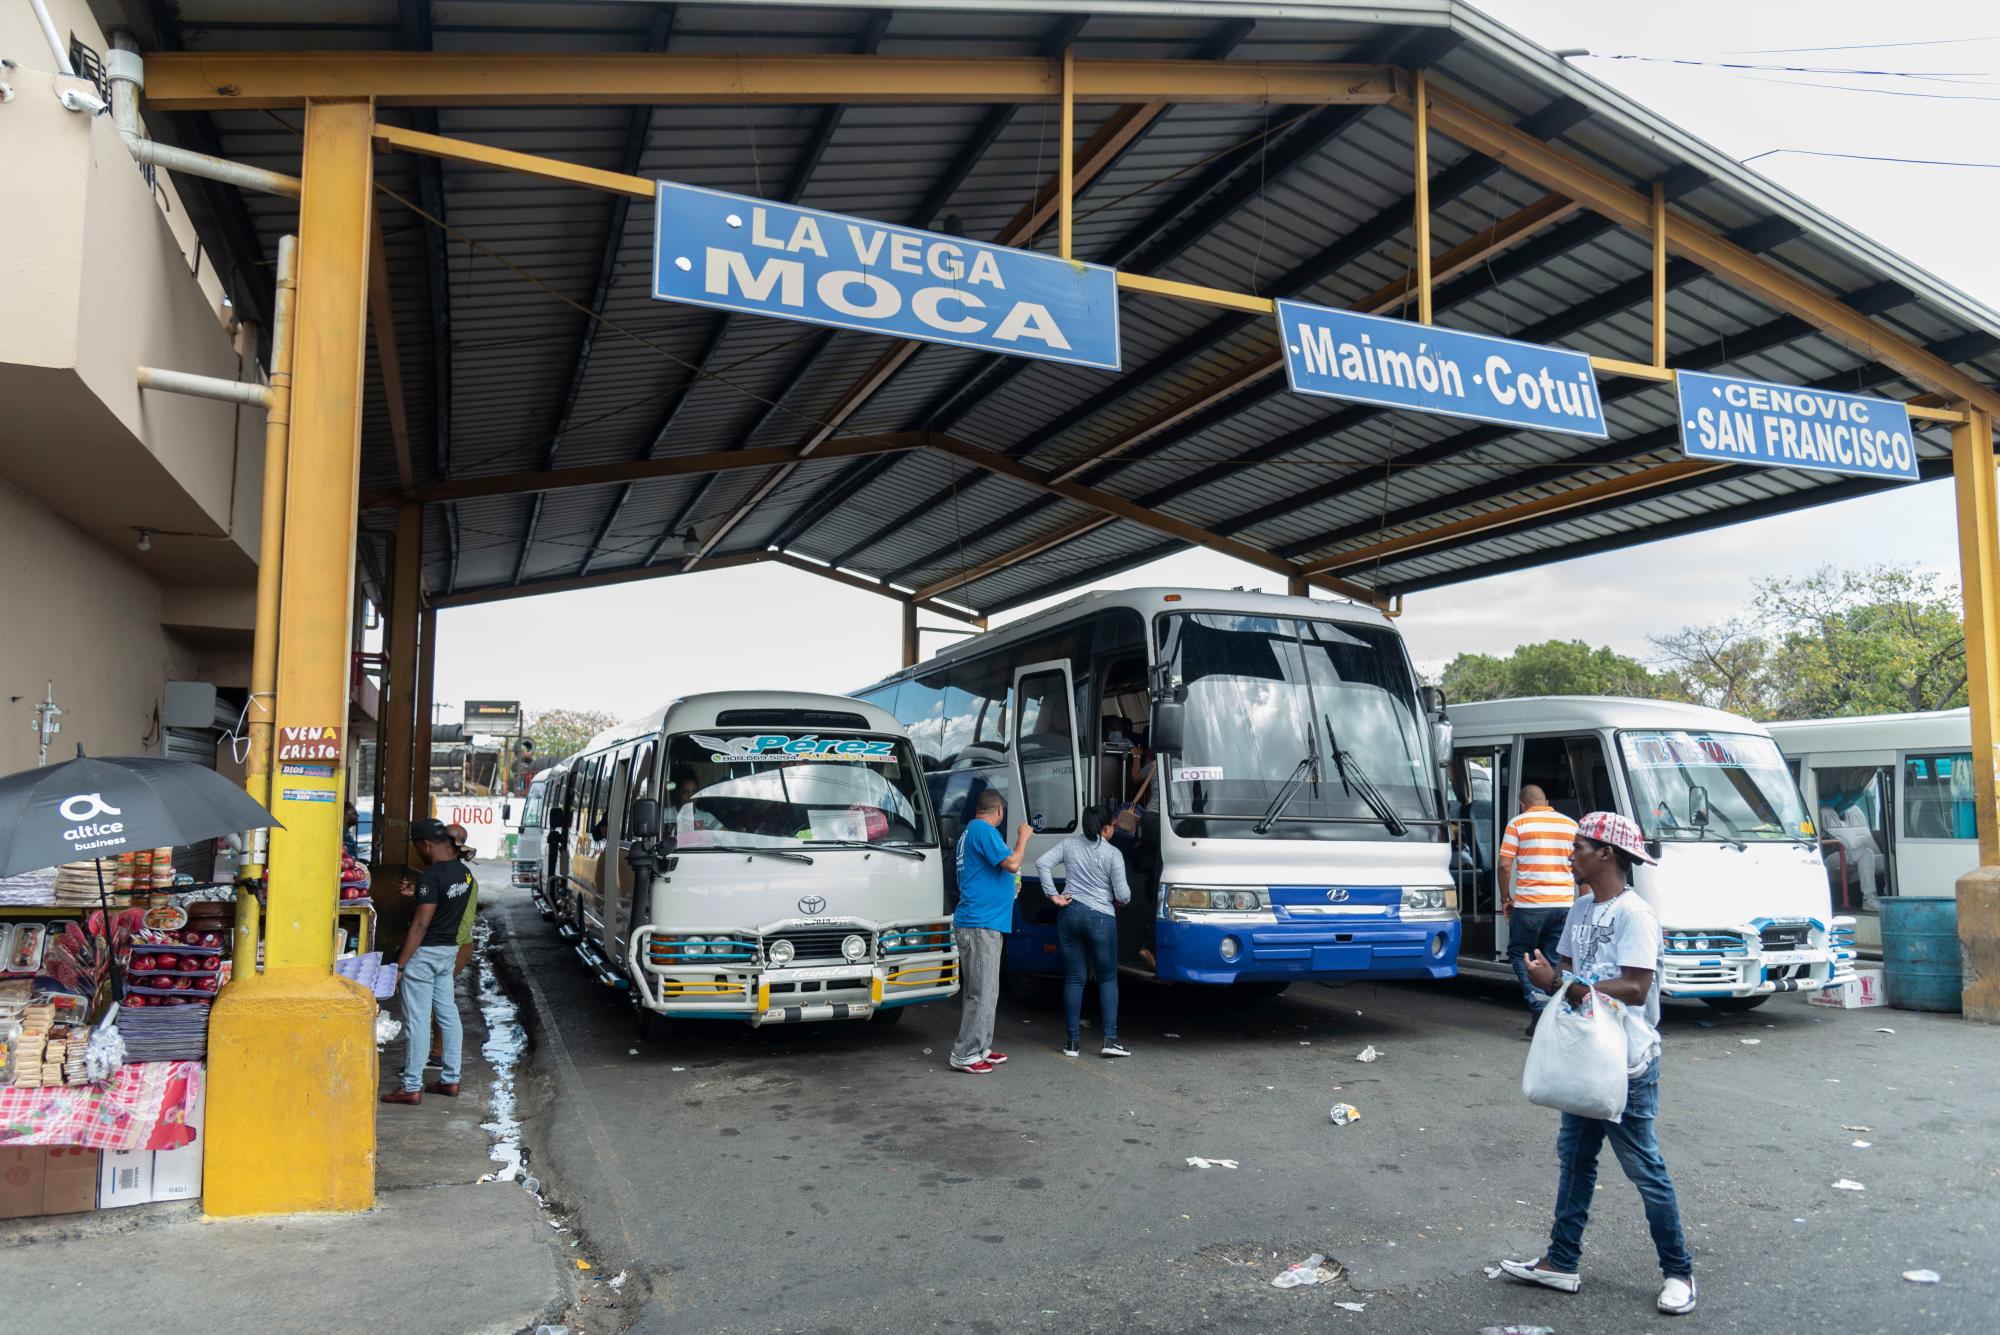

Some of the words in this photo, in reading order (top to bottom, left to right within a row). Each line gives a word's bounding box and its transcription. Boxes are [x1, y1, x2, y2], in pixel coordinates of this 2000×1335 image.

[752, 207, 829, 258] LA
[847, 224, 1006, 290] VEGA
[705, 246, 1073, 350] MOCA
[1298, 323, 1465, 398] Maimón
[1485, 355, 1597, 419] Cotui
[1725, 384, 1870, 424] CENOVIC
[1697, 407, 1757, 455] SAN
[1763, 415, 1911, 471] FRANCISCO
[284, 726, 322, 741] VEN
[751, 735, 896, 756] Pérez
[453, 807, 493, 824] DURO
[63, 822, 124, 841] altice
[74, 837, 127, 851] business
